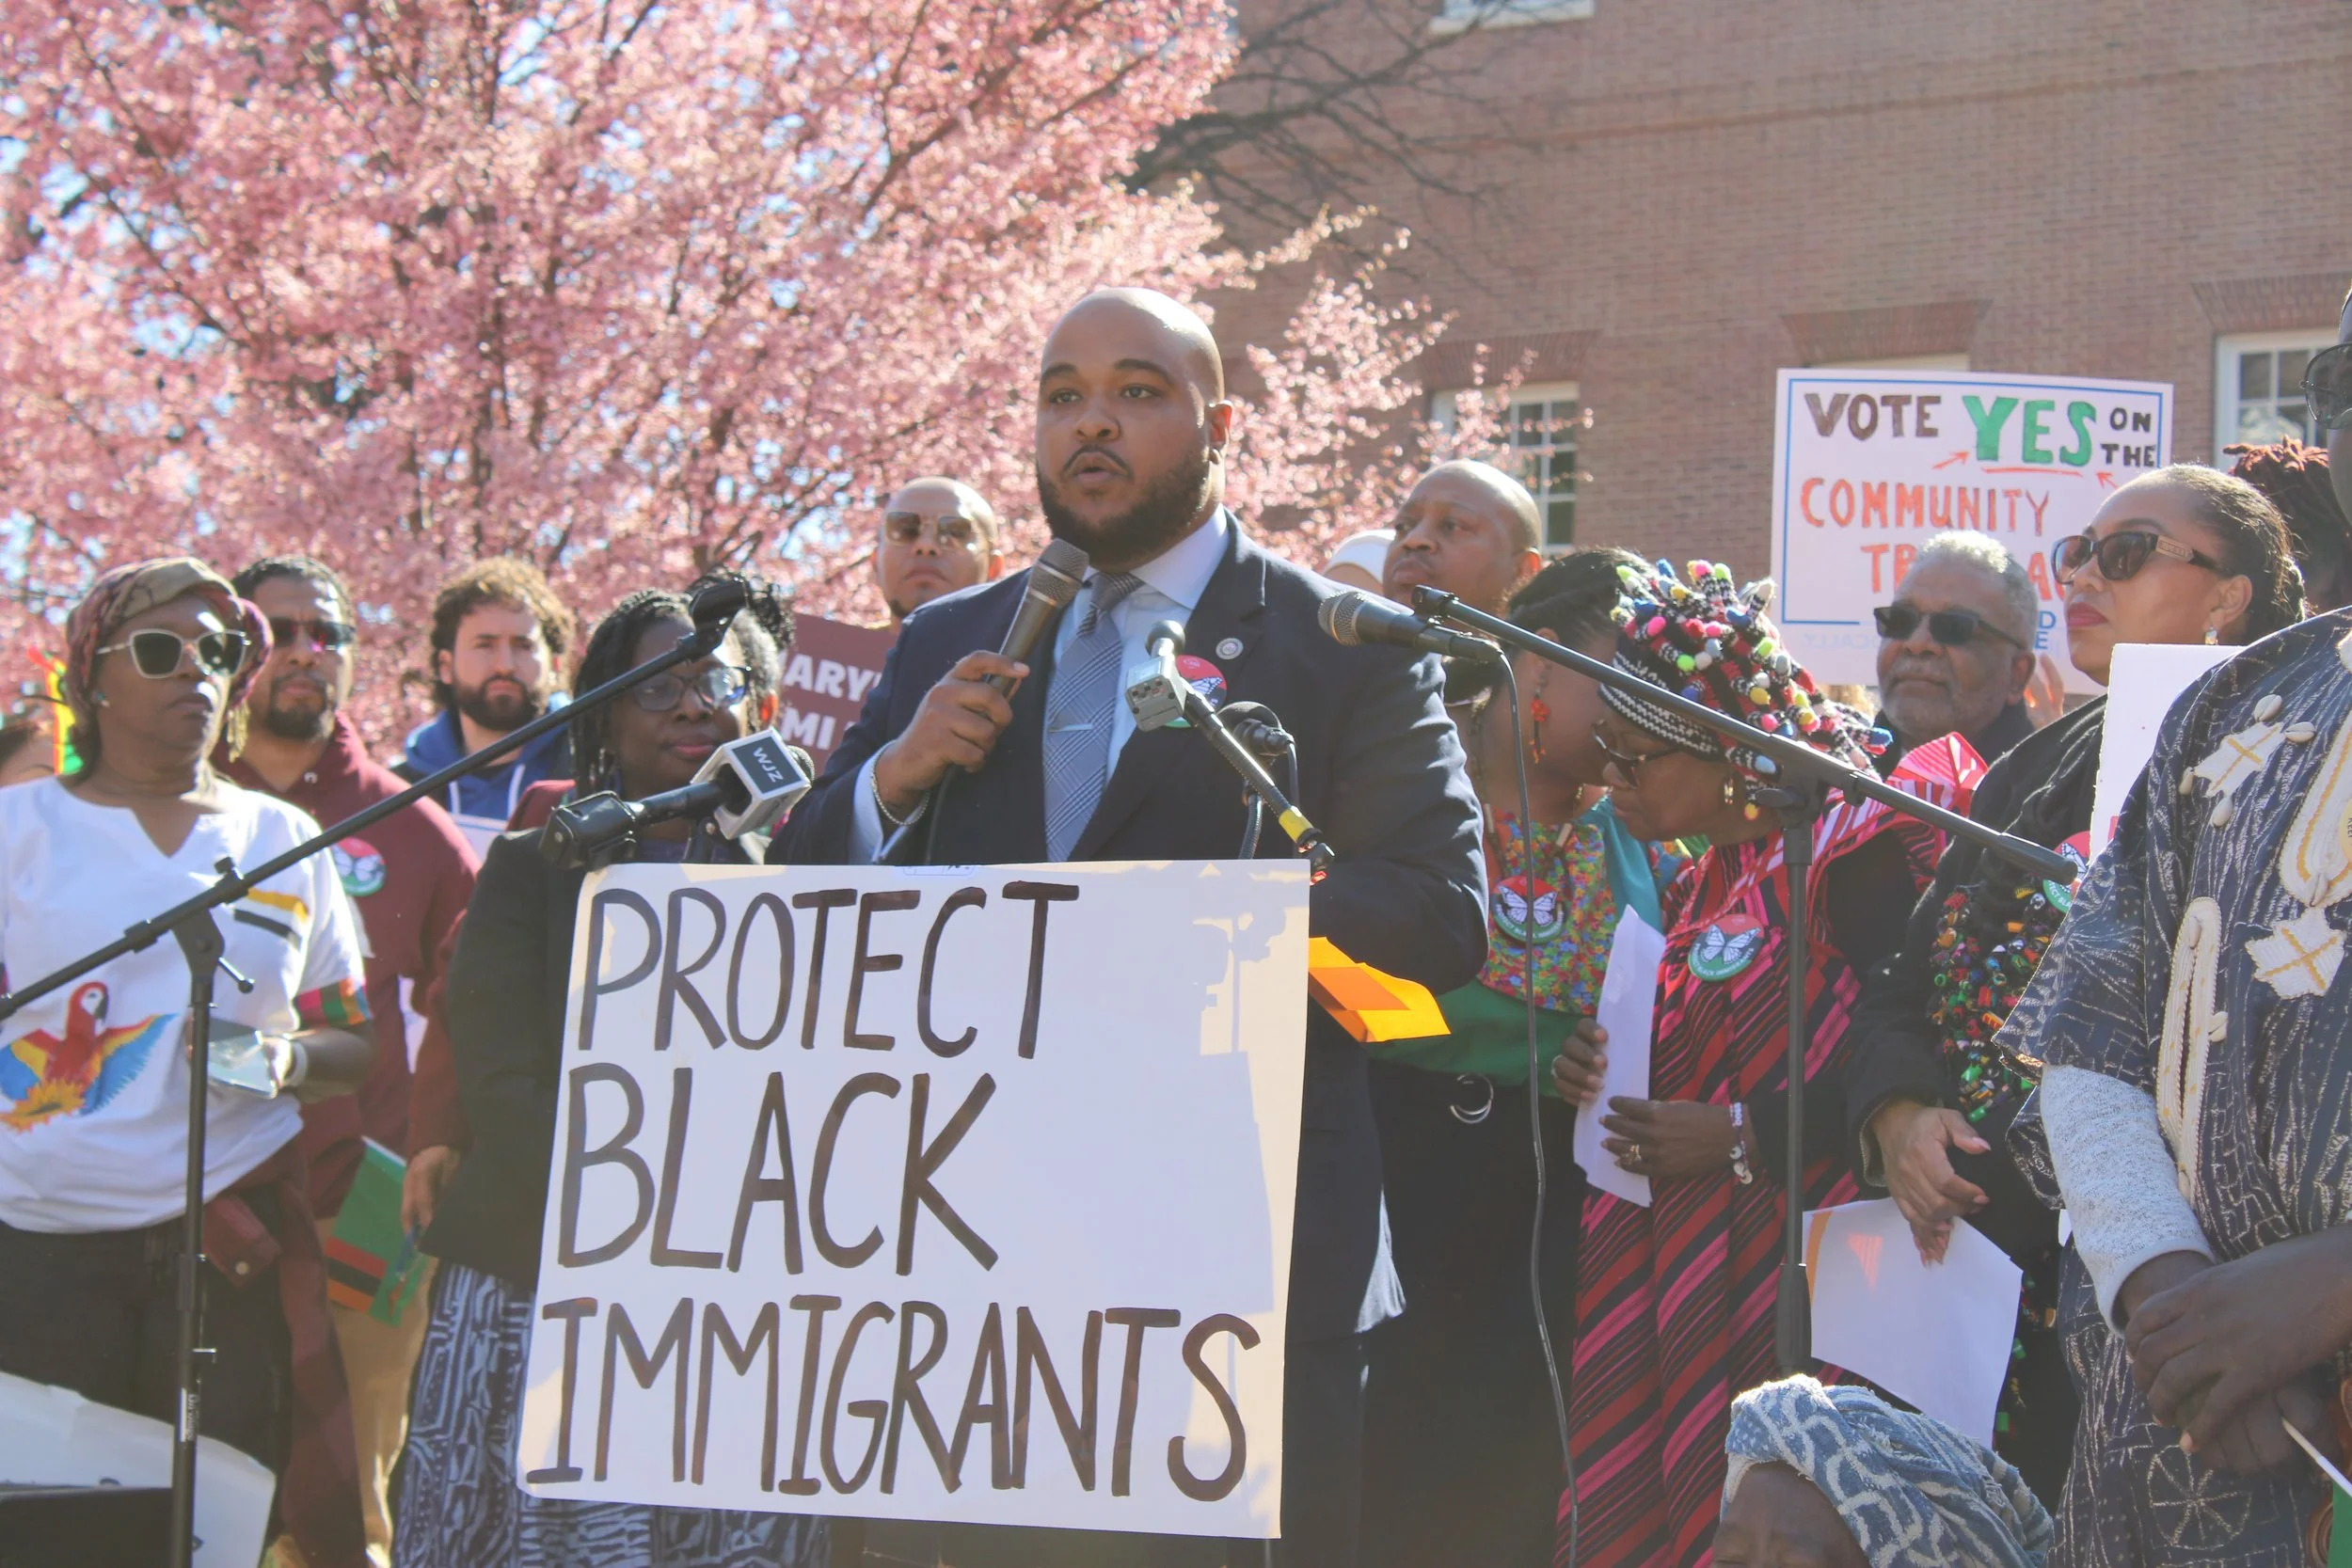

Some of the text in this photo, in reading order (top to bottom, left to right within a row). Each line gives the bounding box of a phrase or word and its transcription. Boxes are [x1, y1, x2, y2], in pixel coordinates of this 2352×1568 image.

[1804, 393, 2152, 467] VOTE YES ON
[2101, 443, 2156, 467] THE
[1801, 477, 2049, 536] COMMUNITY
[754, 747, 784, 783] WJZ
[578, 880, 1080, 1060] PROTECT
[557, 1063, 998, 1276] BLACK
[526, 1294, 1262, 1502] IMMIGRANTS
